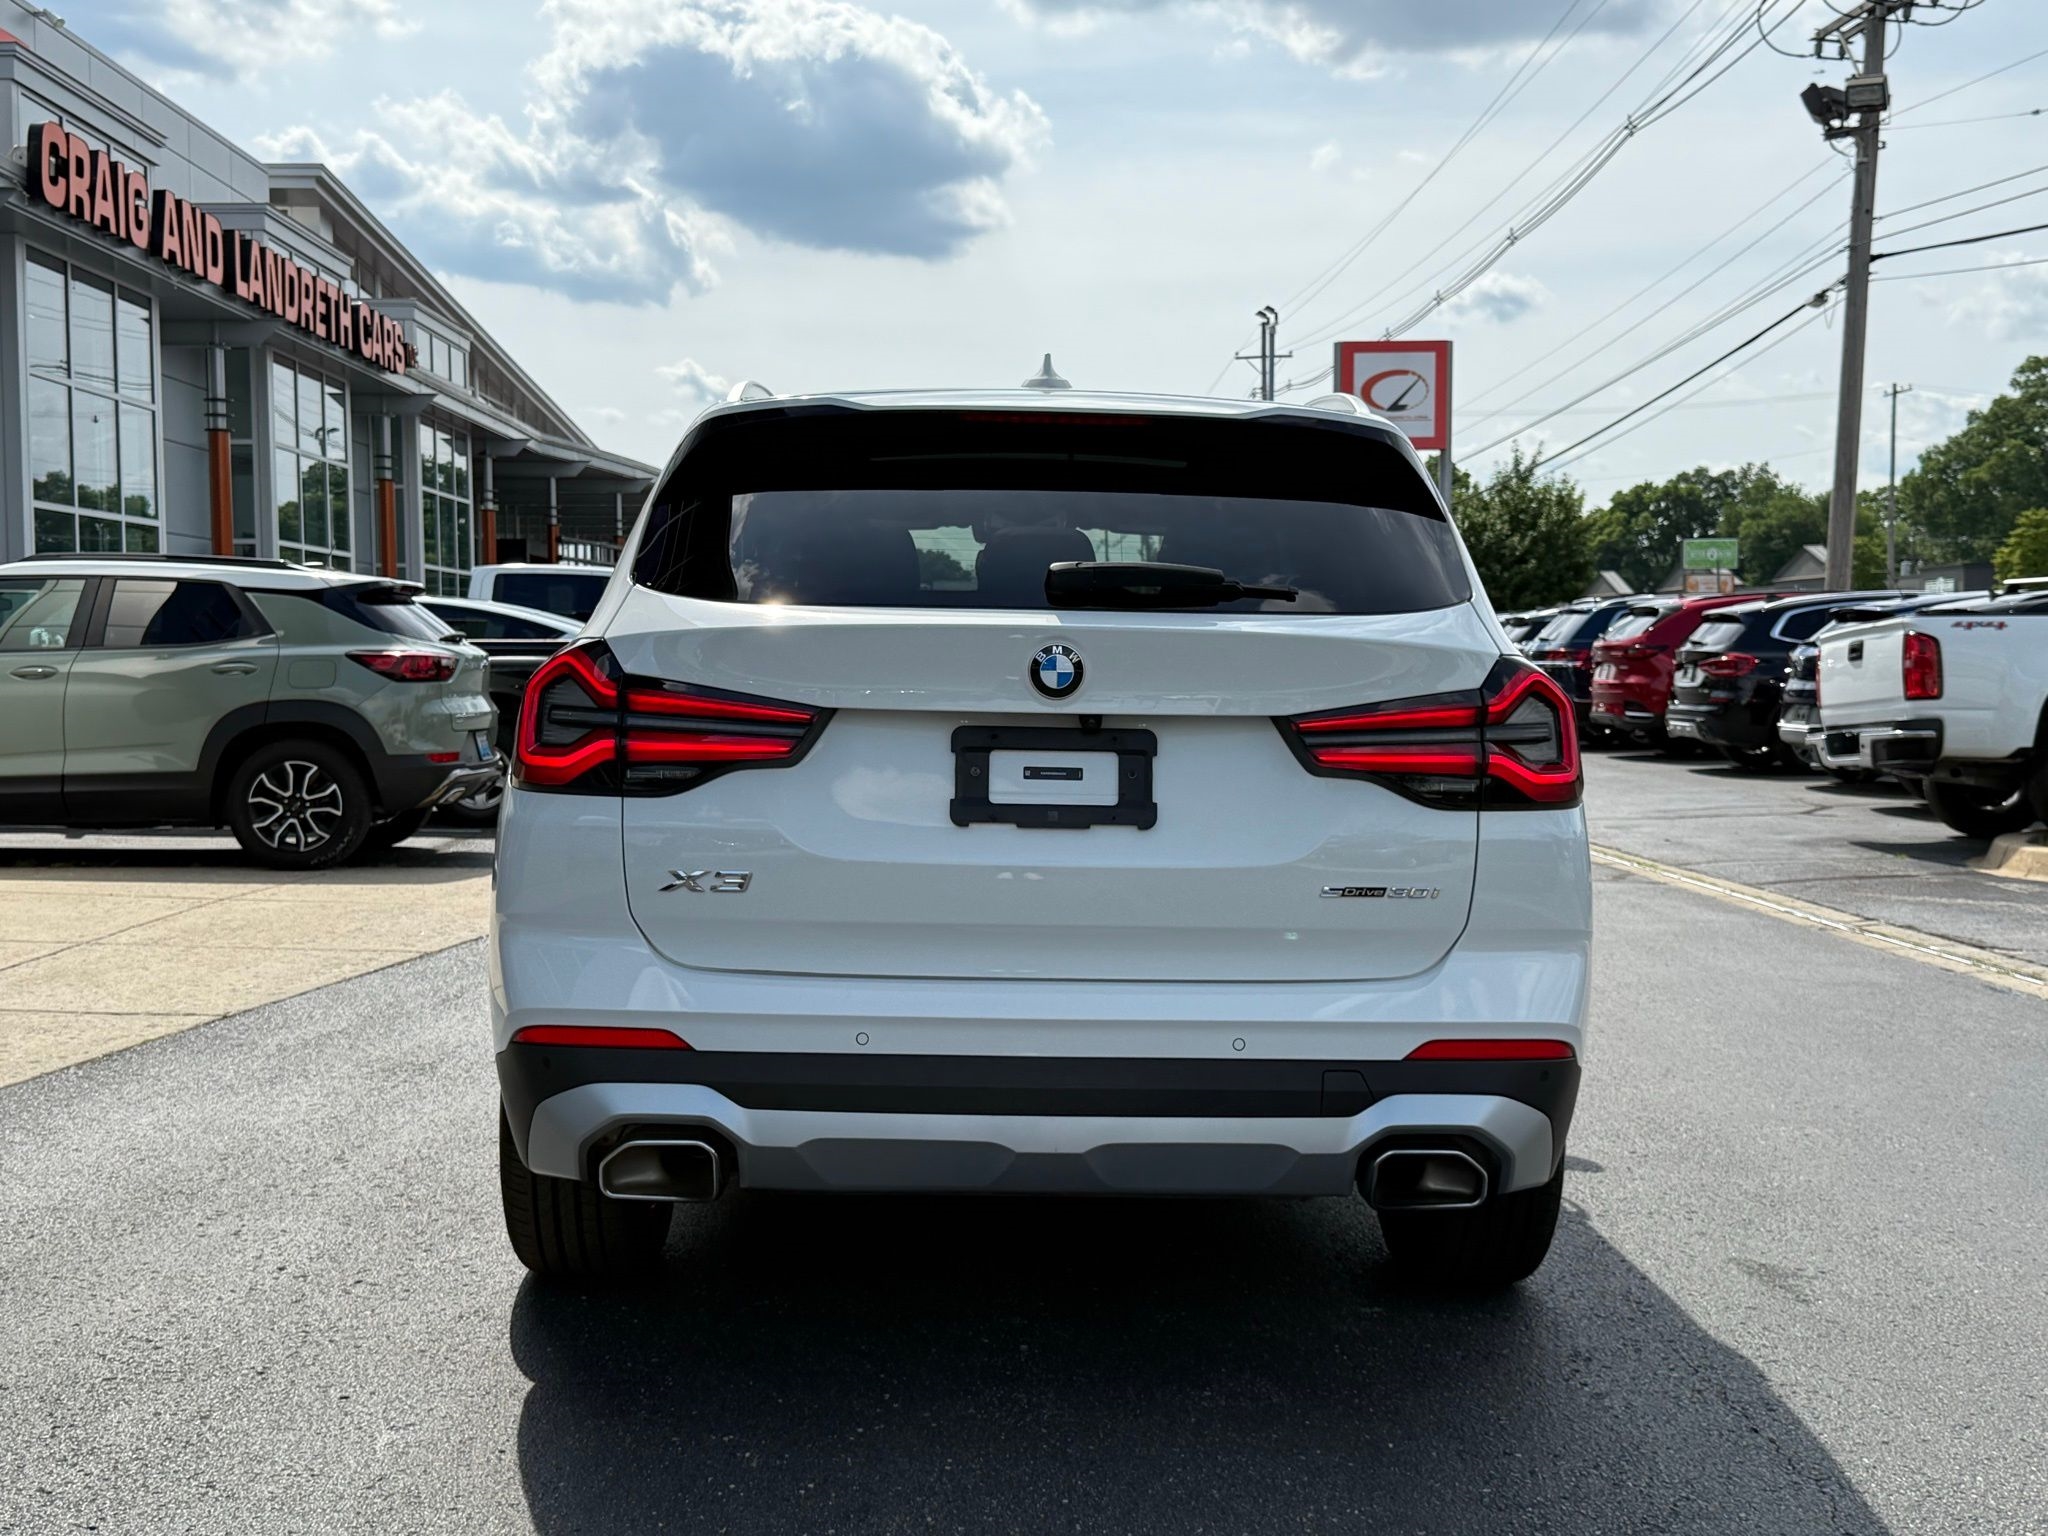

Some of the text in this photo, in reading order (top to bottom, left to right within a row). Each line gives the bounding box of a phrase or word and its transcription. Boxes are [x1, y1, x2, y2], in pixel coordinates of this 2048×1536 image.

[41, 121, 406, 375] CRAIG AND LANDRETH CARS
[1035, 645, 1081, 663] BMW
[658, 870, 753, 893] X3
